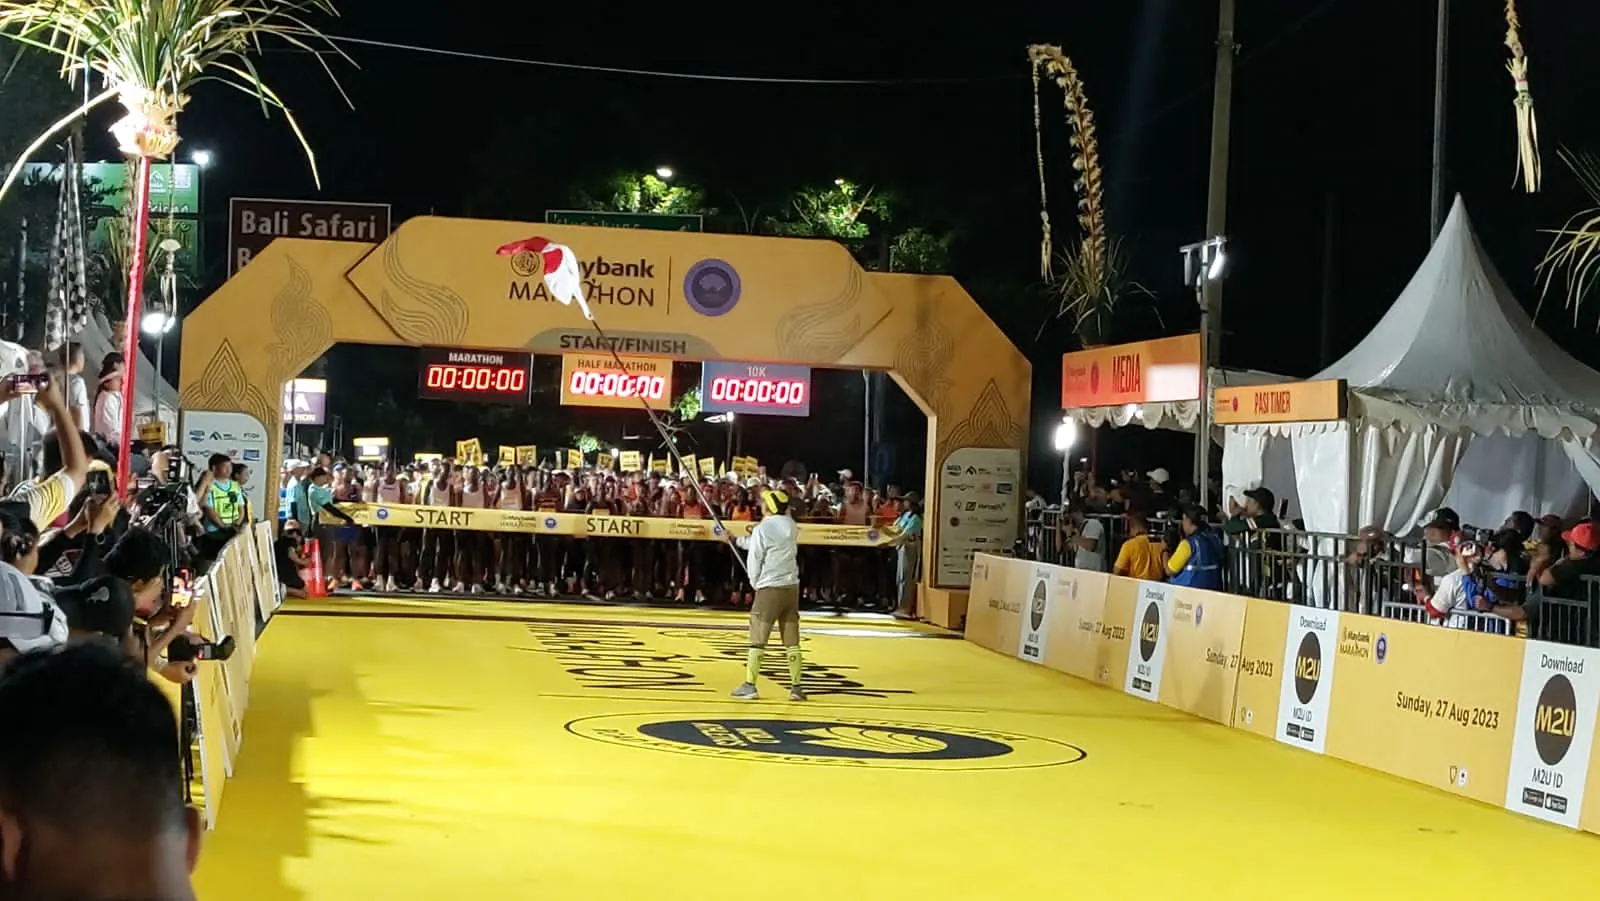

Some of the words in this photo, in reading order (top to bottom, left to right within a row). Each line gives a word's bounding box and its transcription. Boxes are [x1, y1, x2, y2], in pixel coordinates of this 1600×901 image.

[241, 210, 289, 235] Bali
[300, 213, 376, 239] Safari
[577, 256, 655, 279] ybank
[560, 334, 687, 354] START/FINISH
[448, 353, 504, 365] MARATHON
[577, 359, 602, 370] HALF
[603, 360, 657, 372] MARATHON
[427, 367, 525, 392] 00:00:00
[747, 366, 767, 378] 10K
[1112, 353, 1141, 393] MEDIA
[569, 371, 666, 400] 00:00:00
[711, 377, 804, 405] 00:00:00
[1254, 391, 1269, 416] PASI
[1270, 391, 1291, 414] TIMER
[414, 508, 475, 527] START
[586, 517, 645, 536] START
[1229, 654, 1238, 669] 27
[1241, 657, 1254, 676] Aug
[1255, 661, 1274, 678] 2023
[1295, 655, 1322, 681] M2U
[1541, 654, 1584, 674] Download
[1396, 691, 1434, 718] Sunday,
[1435, 699, 1449, 718] 27
[1449, 703, 1470, 727] Aug
[1471, 707, 1500, 729] 2023
[1534, 704, 1575, 736] M2U
[1532, 767, 1552, 786] M2U
[1552, 772, 1564, 789] ID
